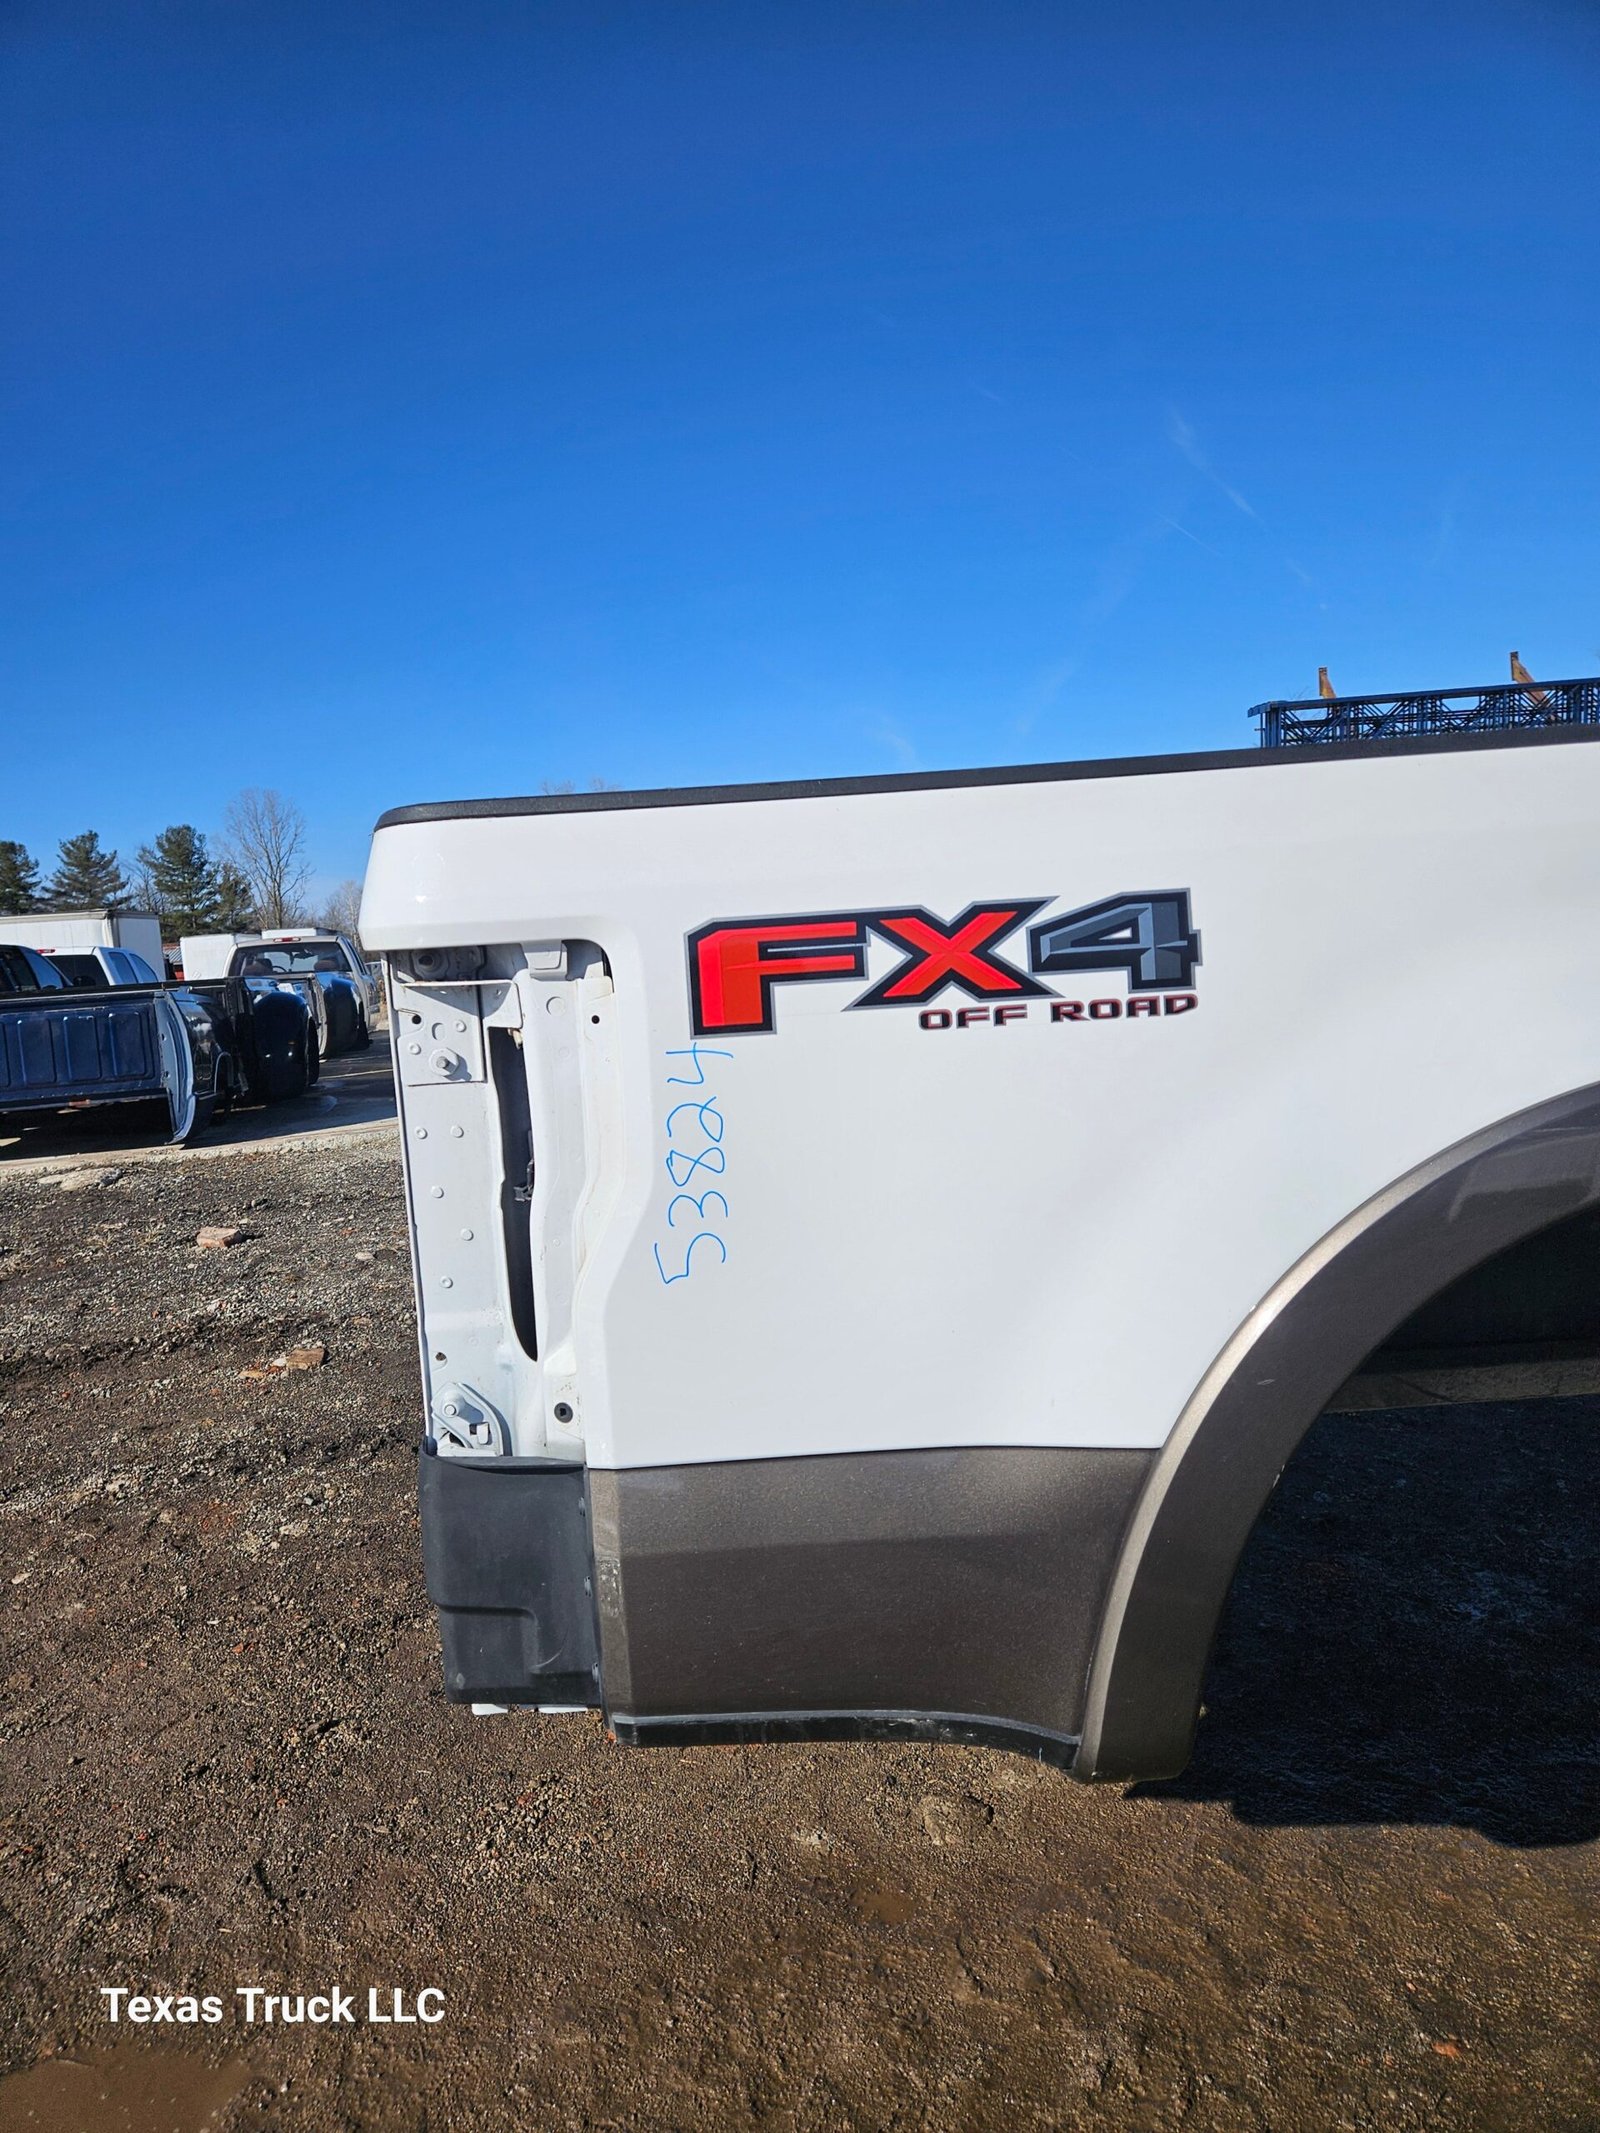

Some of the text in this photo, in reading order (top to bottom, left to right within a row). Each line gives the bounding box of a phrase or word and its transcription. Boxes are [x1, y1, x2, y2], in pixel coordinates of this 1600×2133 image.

[684, 888, 1202, 1039] FX4
[918, 994, 1199, 1031] OFF ROAD
[654, 1042, 734, 1285] 53824
